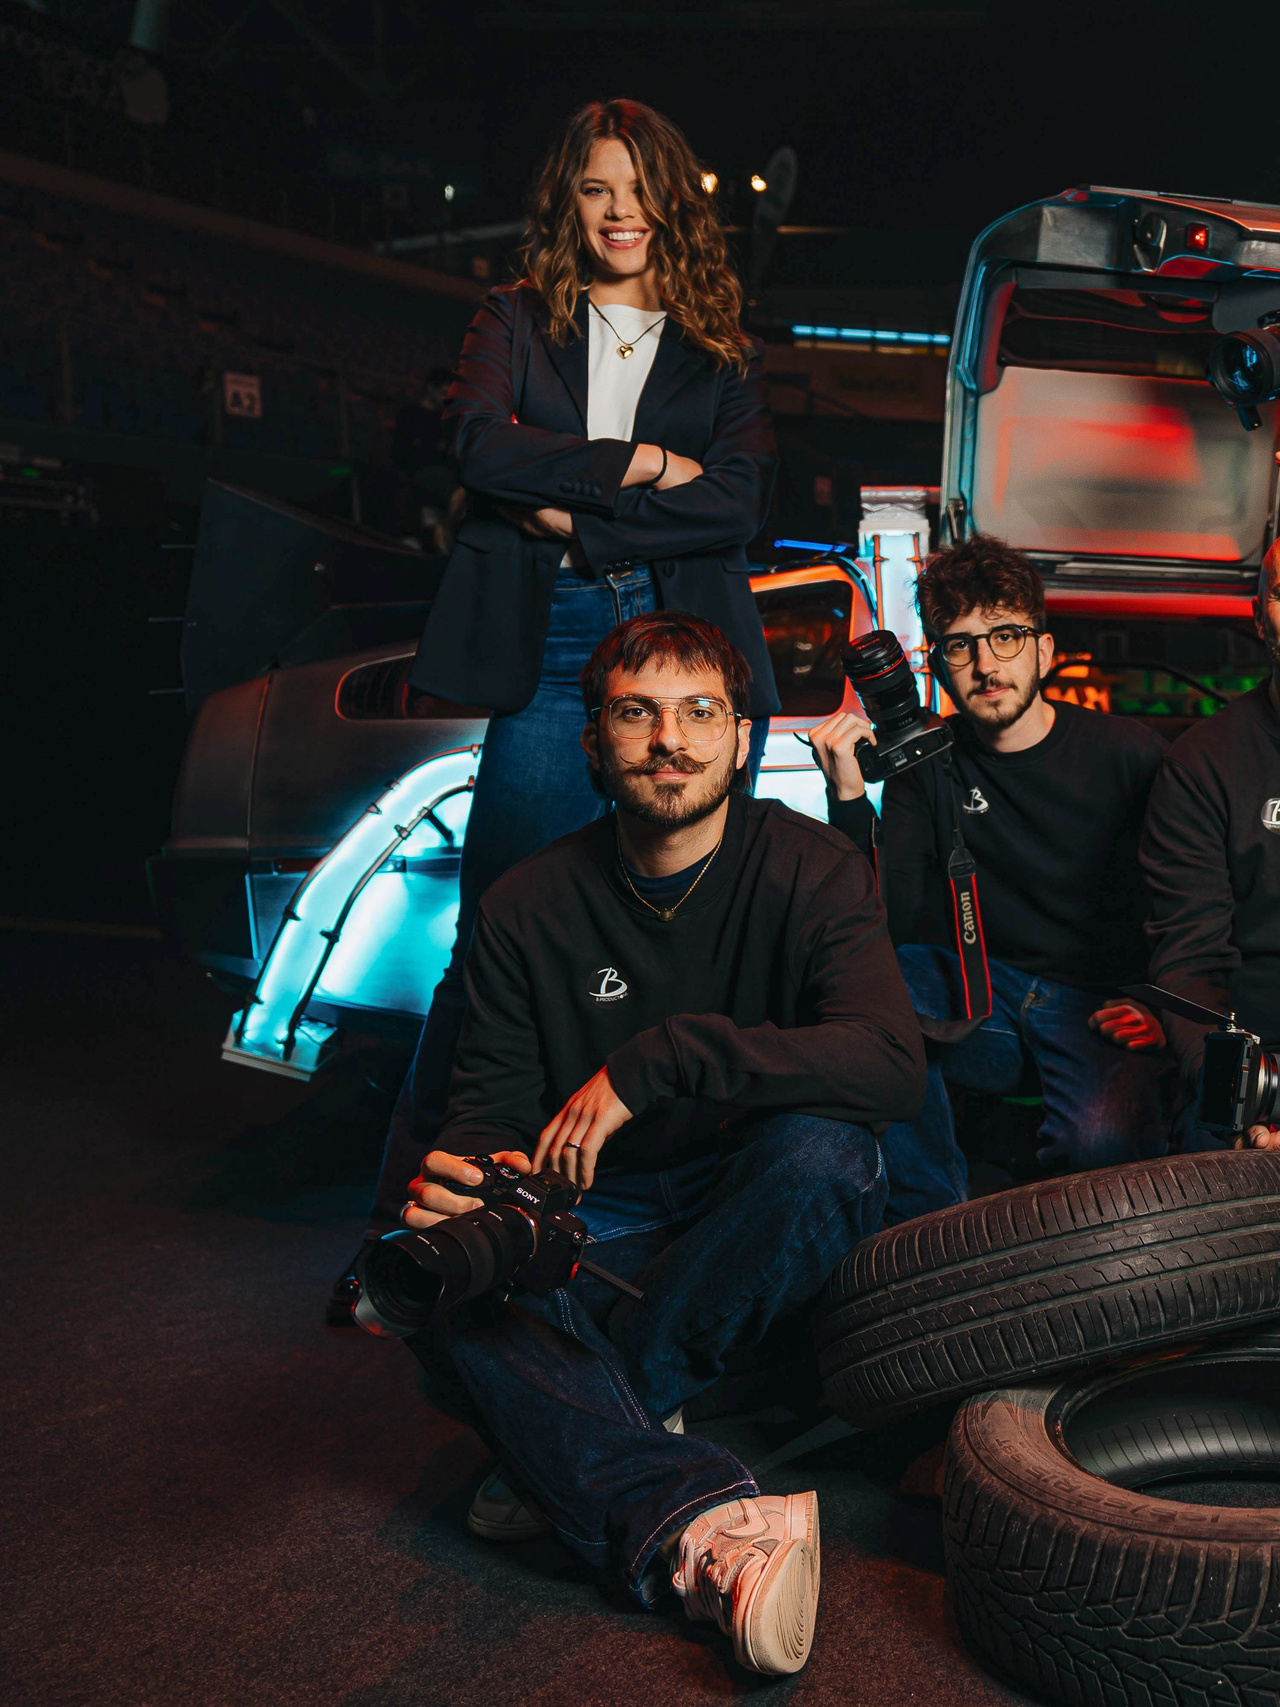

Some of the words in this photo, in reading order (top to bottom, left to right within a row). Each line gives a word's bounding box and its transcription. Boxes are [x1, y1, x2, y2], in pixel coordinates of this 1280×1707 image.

[962, 785, 989, 811] B
[960, 891, 977, 945] Canon
[588, 967, 628, 998] B
[516, 1187, 541, 1205] SONY
